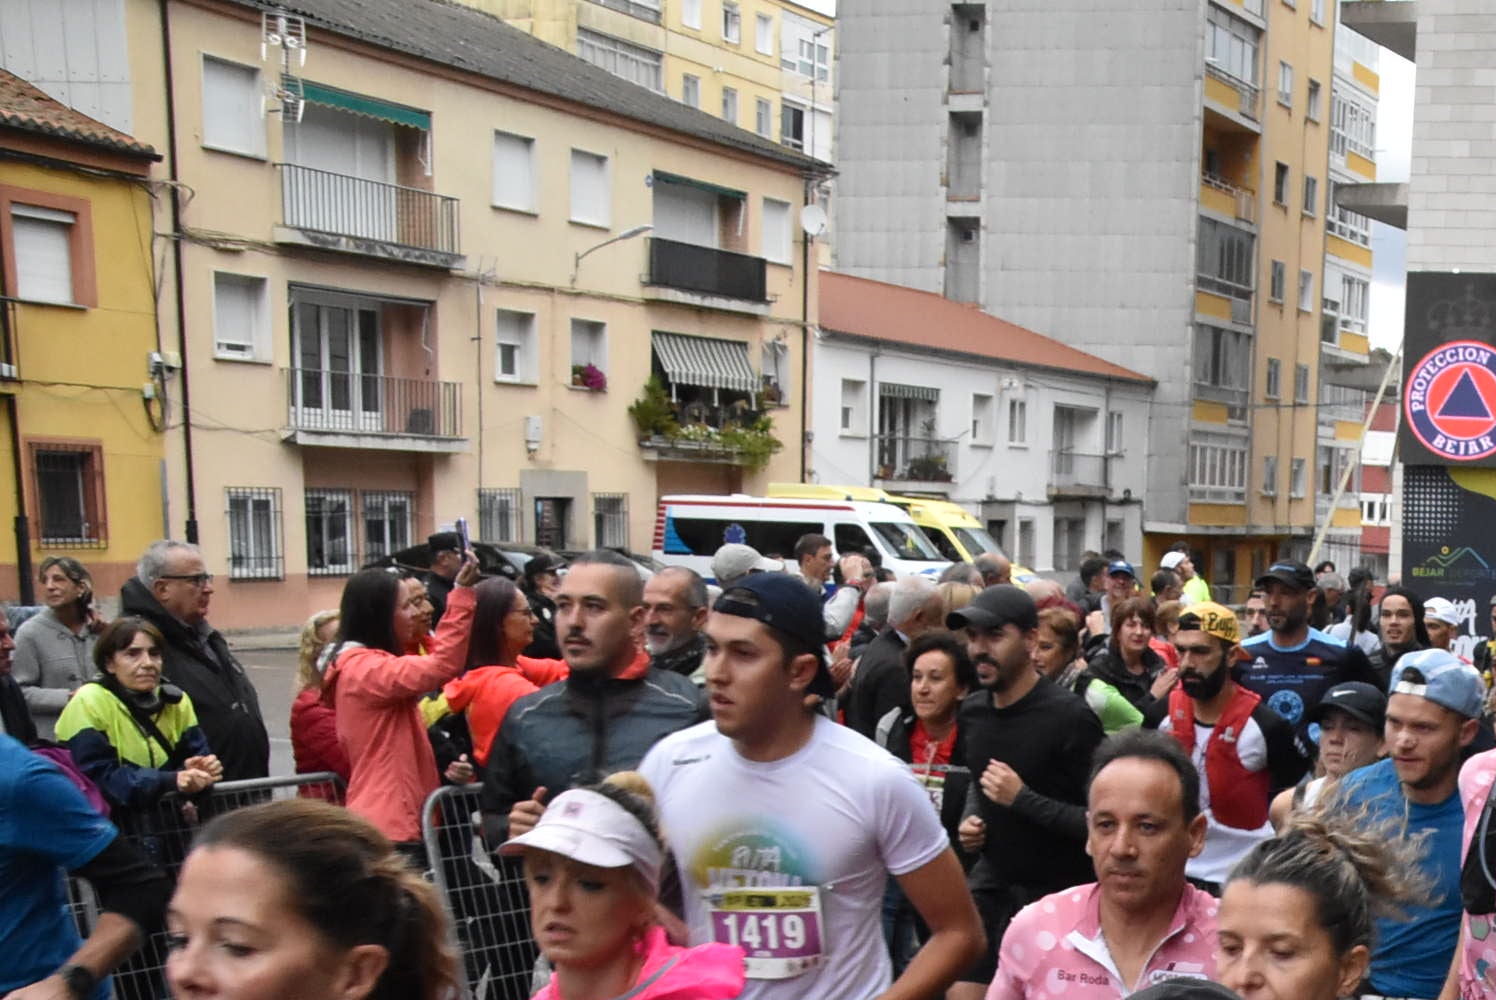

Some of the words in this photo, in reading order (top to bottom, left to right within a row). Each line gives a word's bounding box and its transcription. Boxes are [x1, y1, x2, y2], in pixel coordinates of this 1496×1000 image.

[1411, 347, 1491, 412] PROTECCION
[722, 914, 806, 950] 1419
[1079, 973, 1110, 986] Roda
